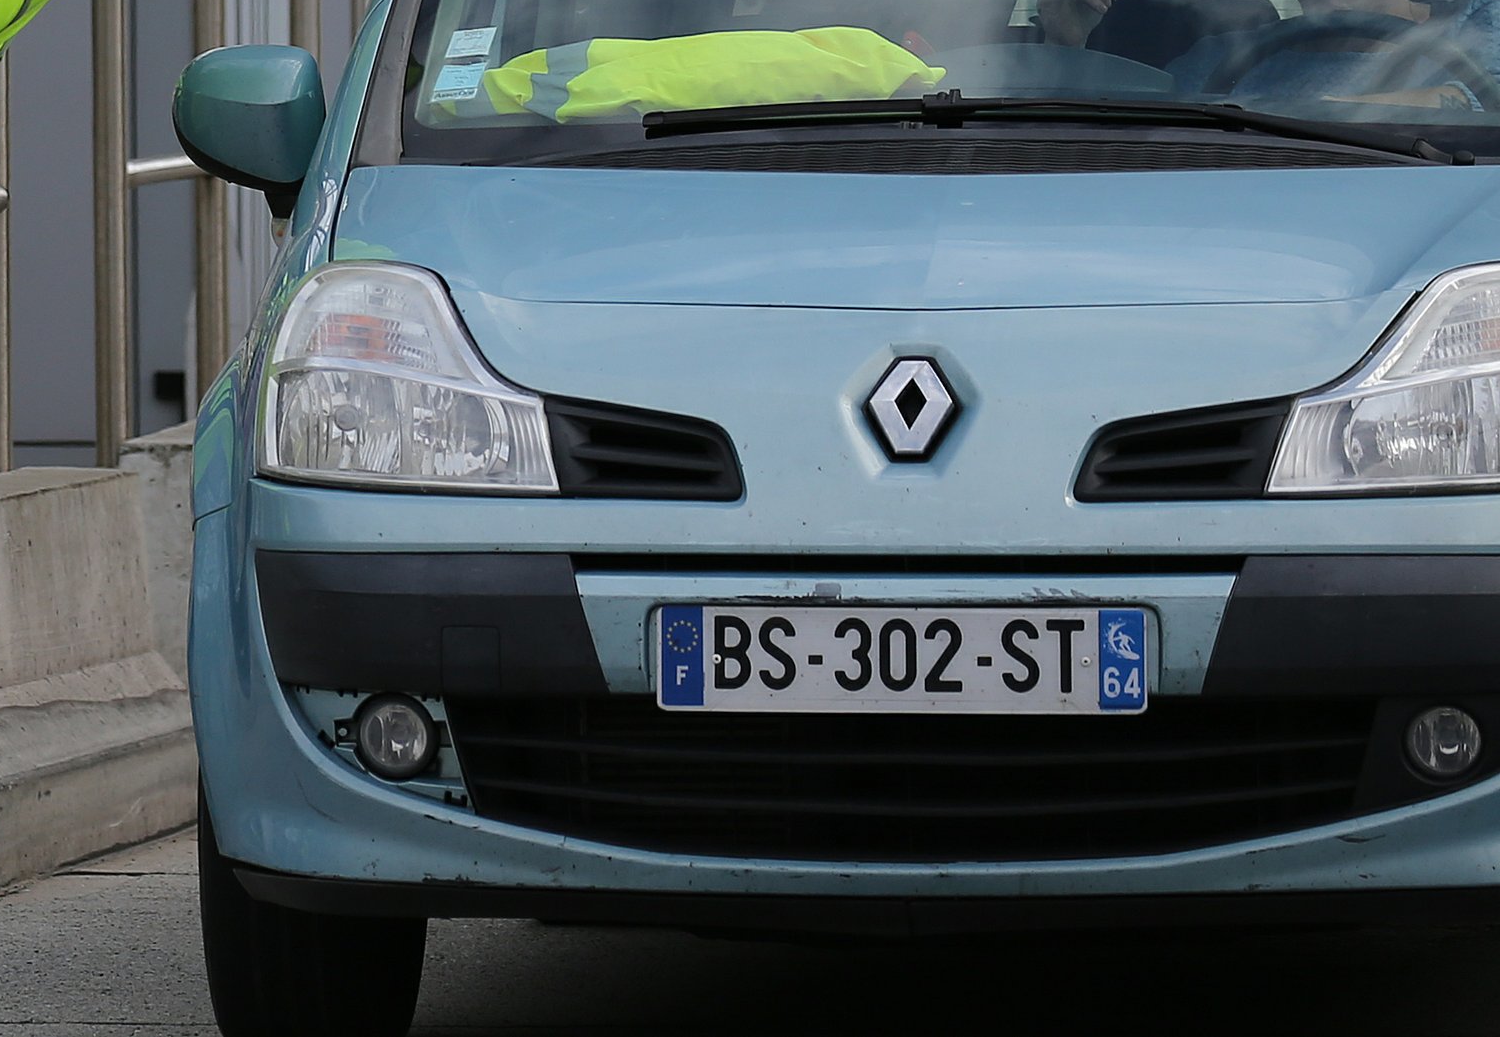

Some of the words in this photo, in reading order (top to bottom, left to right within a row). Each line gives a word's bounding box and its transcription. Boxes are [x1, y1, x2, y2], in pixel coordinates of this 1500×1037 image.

[675, 665, 689, 685] F
[713, 616, 1086, 694] BS-302-ST
[1103, 666, 1142, 699] 64
